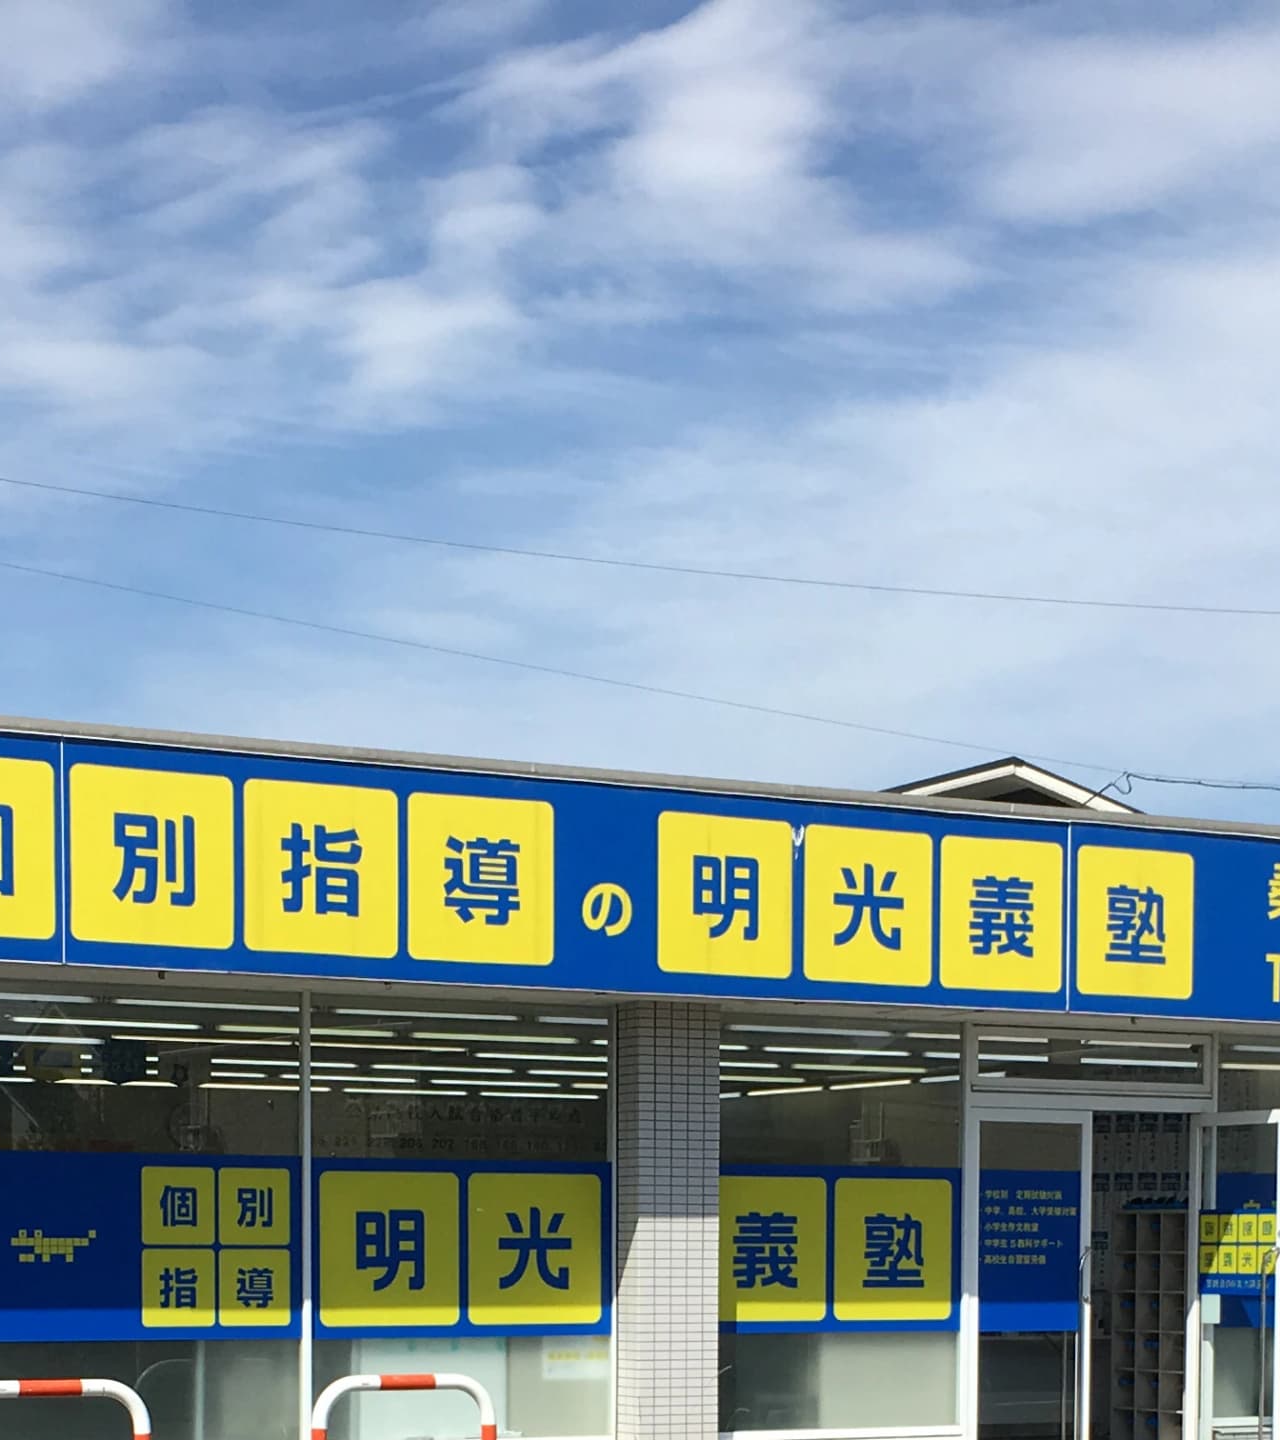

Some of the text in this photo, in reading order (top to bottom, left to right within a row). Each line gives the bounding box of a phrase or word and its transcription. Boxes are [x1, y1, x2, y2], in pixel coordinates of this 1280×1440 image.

[160, 1184, 274, 1229] 個別
[355, 1206, 926, 1292] 明光 義塾
[159, 1266, 275, 1309] 指導
